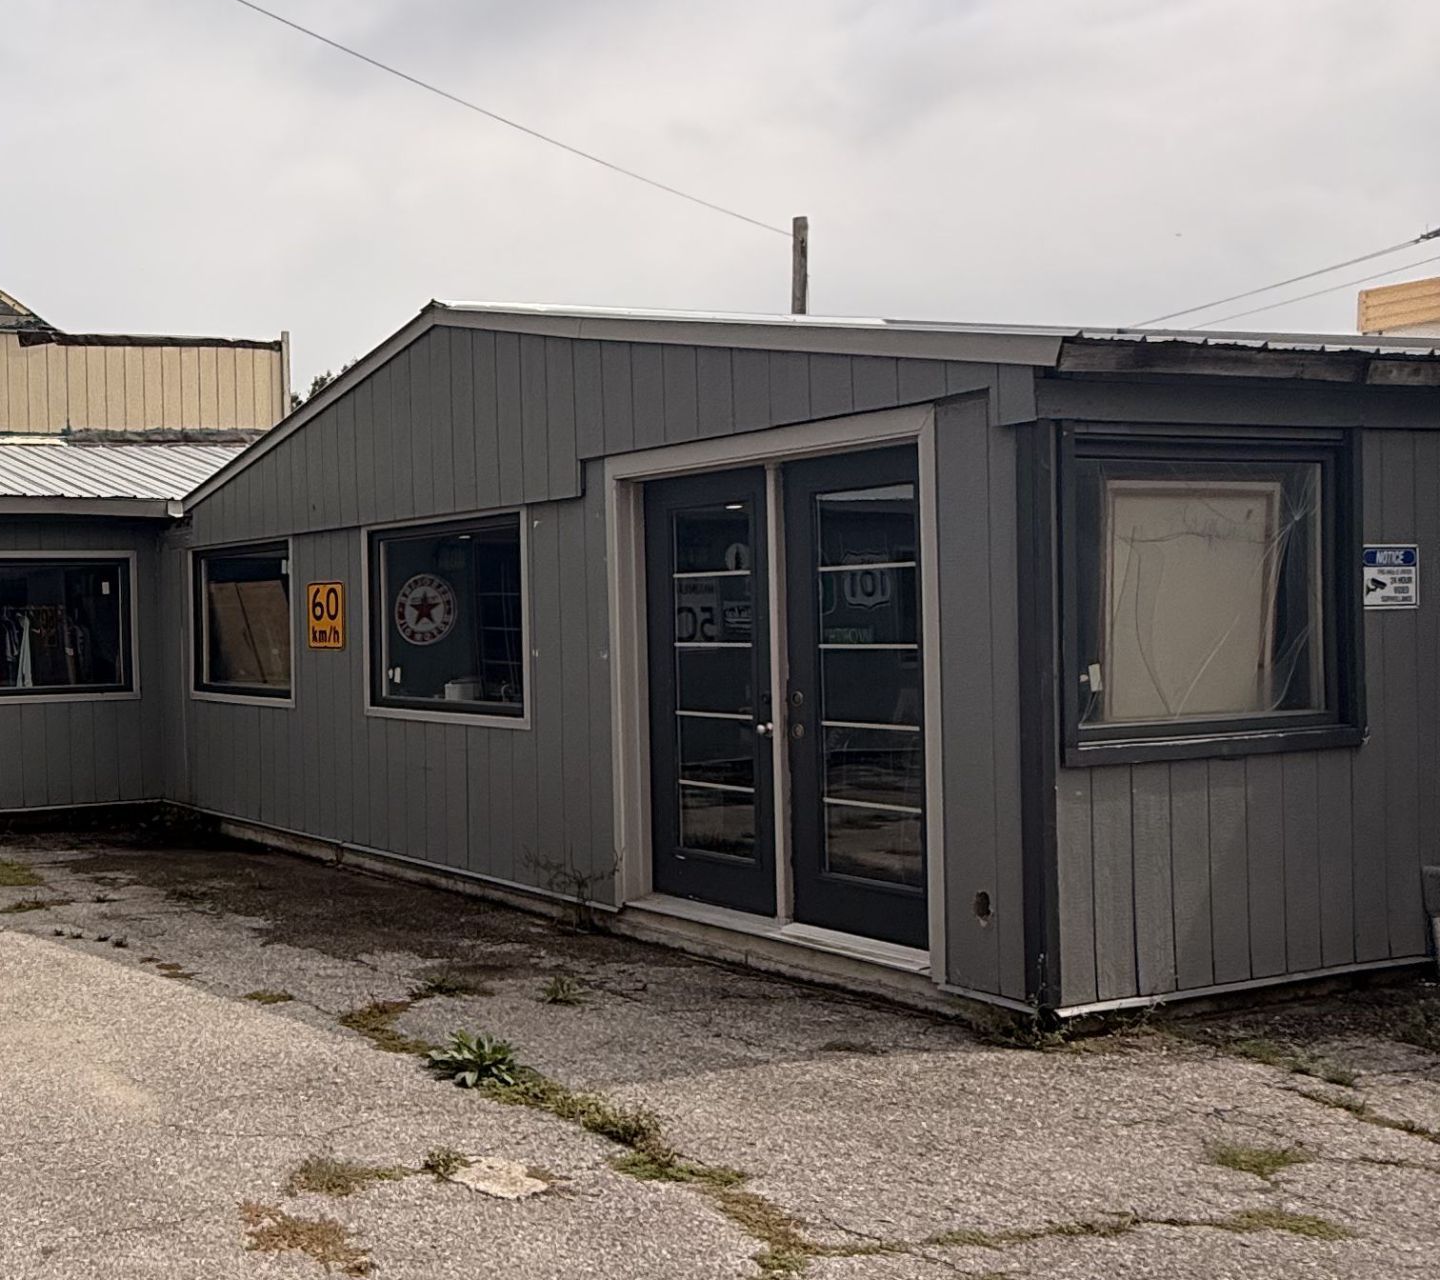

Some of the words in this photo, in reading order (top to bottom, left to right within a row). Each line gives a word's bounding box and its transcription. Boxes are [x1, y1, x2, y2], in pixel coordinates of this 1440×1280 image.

[1376, 550, 1405, 565] NOTICE
[311, 587, 339, 621] 60
[311, 625, 340, 643] km/h
